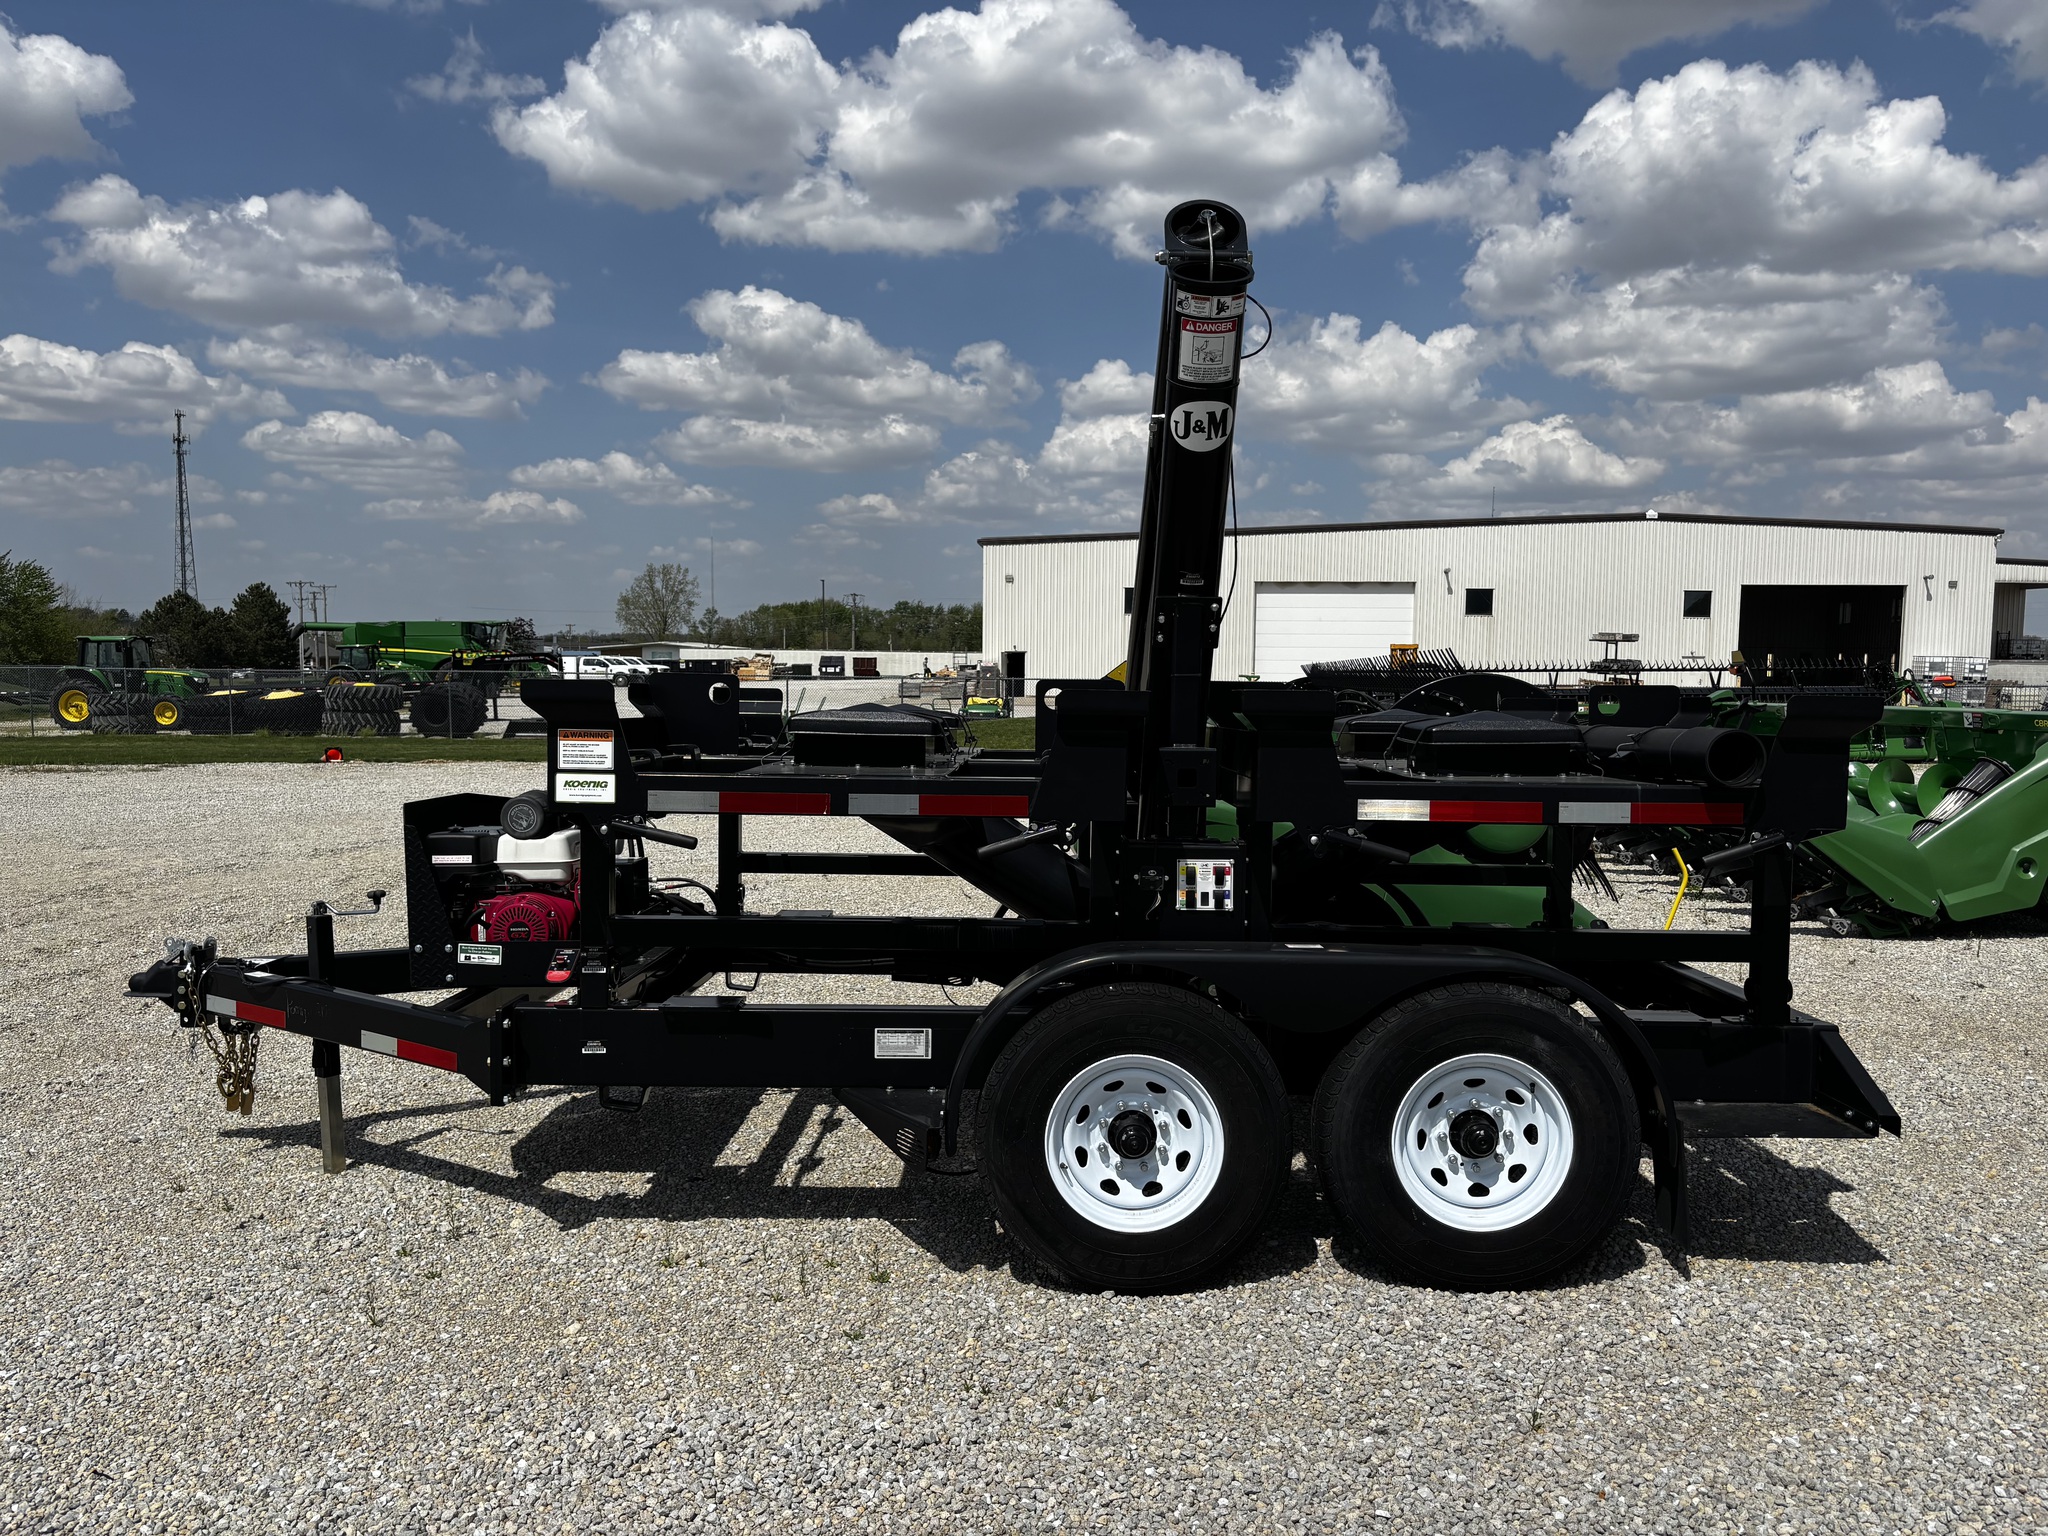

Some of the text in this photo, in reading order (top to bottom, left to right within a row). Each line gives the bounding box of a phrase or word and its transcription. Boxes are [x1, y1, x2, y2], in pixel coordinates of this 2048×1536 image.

[1196, 322, 1233, 332] DANGER
[1173, 407, 1229, 441] J&M
[570, 731, 610, 740] WARNING
